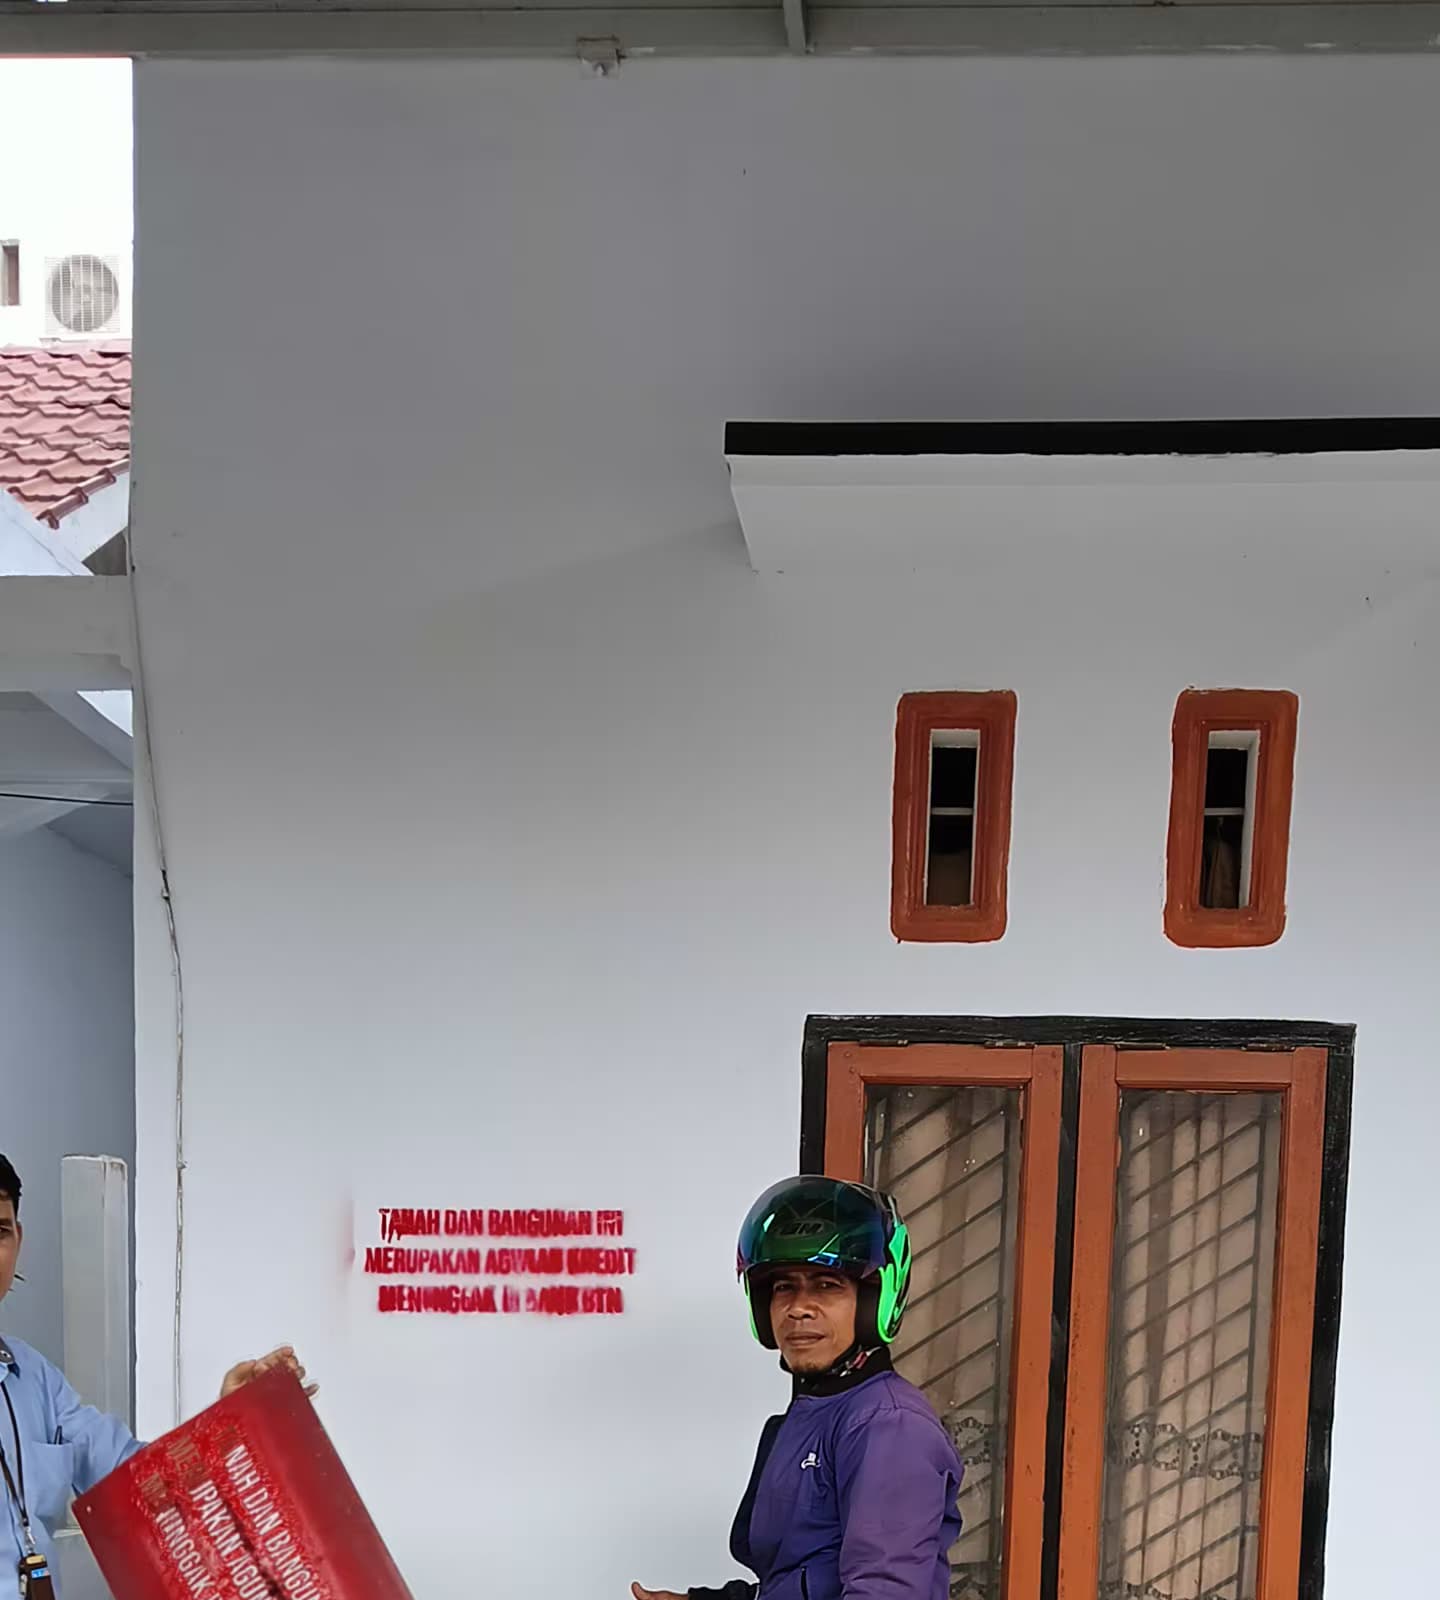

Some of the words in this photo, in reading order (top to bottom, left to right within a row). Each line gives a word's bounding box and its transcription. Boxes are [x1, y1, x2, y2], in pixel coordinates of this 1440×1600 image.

[444, 1208, 483, 1236] DAN
[365, 1247, 480, 1274] MERUPAKAN
[566, 1248, 636, 1275] EDIT
[242, 1486, 282, 1536] DAN
